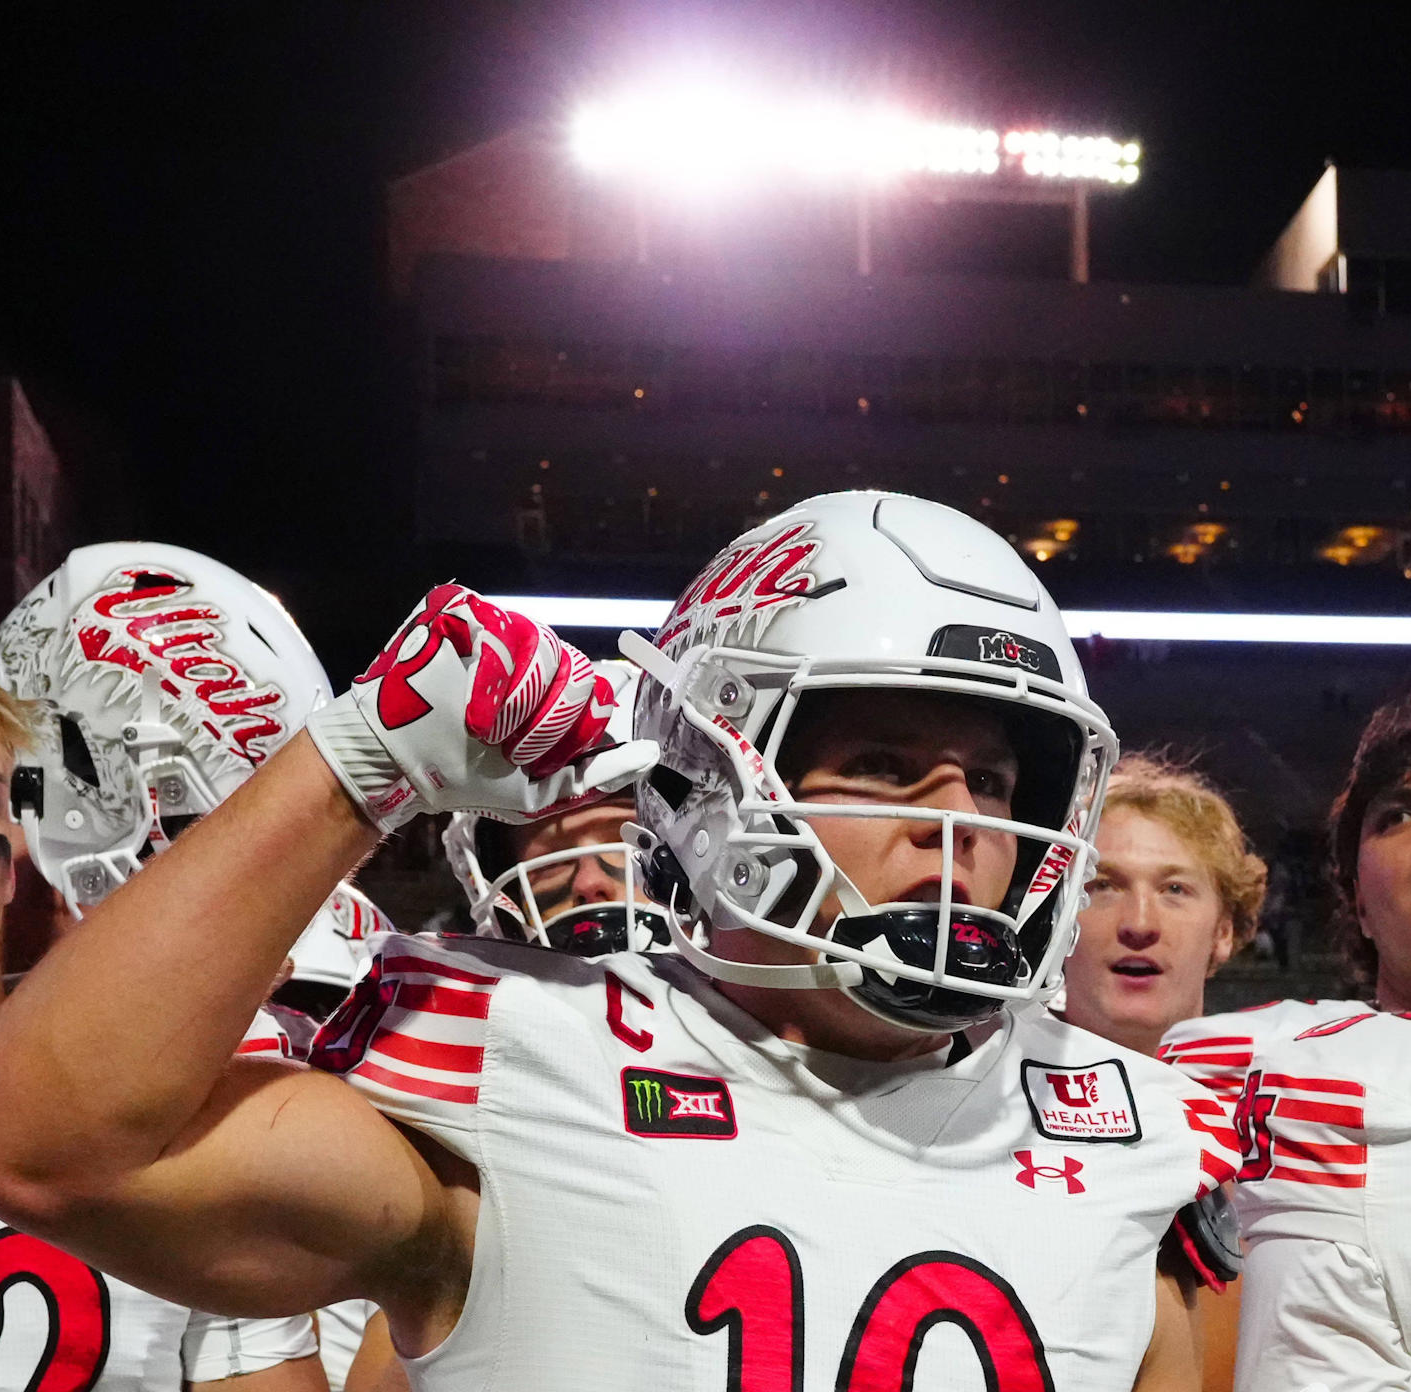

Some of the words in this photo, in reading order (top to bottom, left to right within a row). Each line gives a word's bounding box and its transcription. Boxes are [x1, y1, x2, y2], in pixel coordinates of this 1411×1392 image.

[1028, 844, 1074, 895] UTAH
[605, 970, 655, 1053] C
[668, 1089, 725, 1119] XII
[1042, 1109, 1128, 1125] HEALTH
[1046, 1124, 1092, 1133] UNIVERSITY
